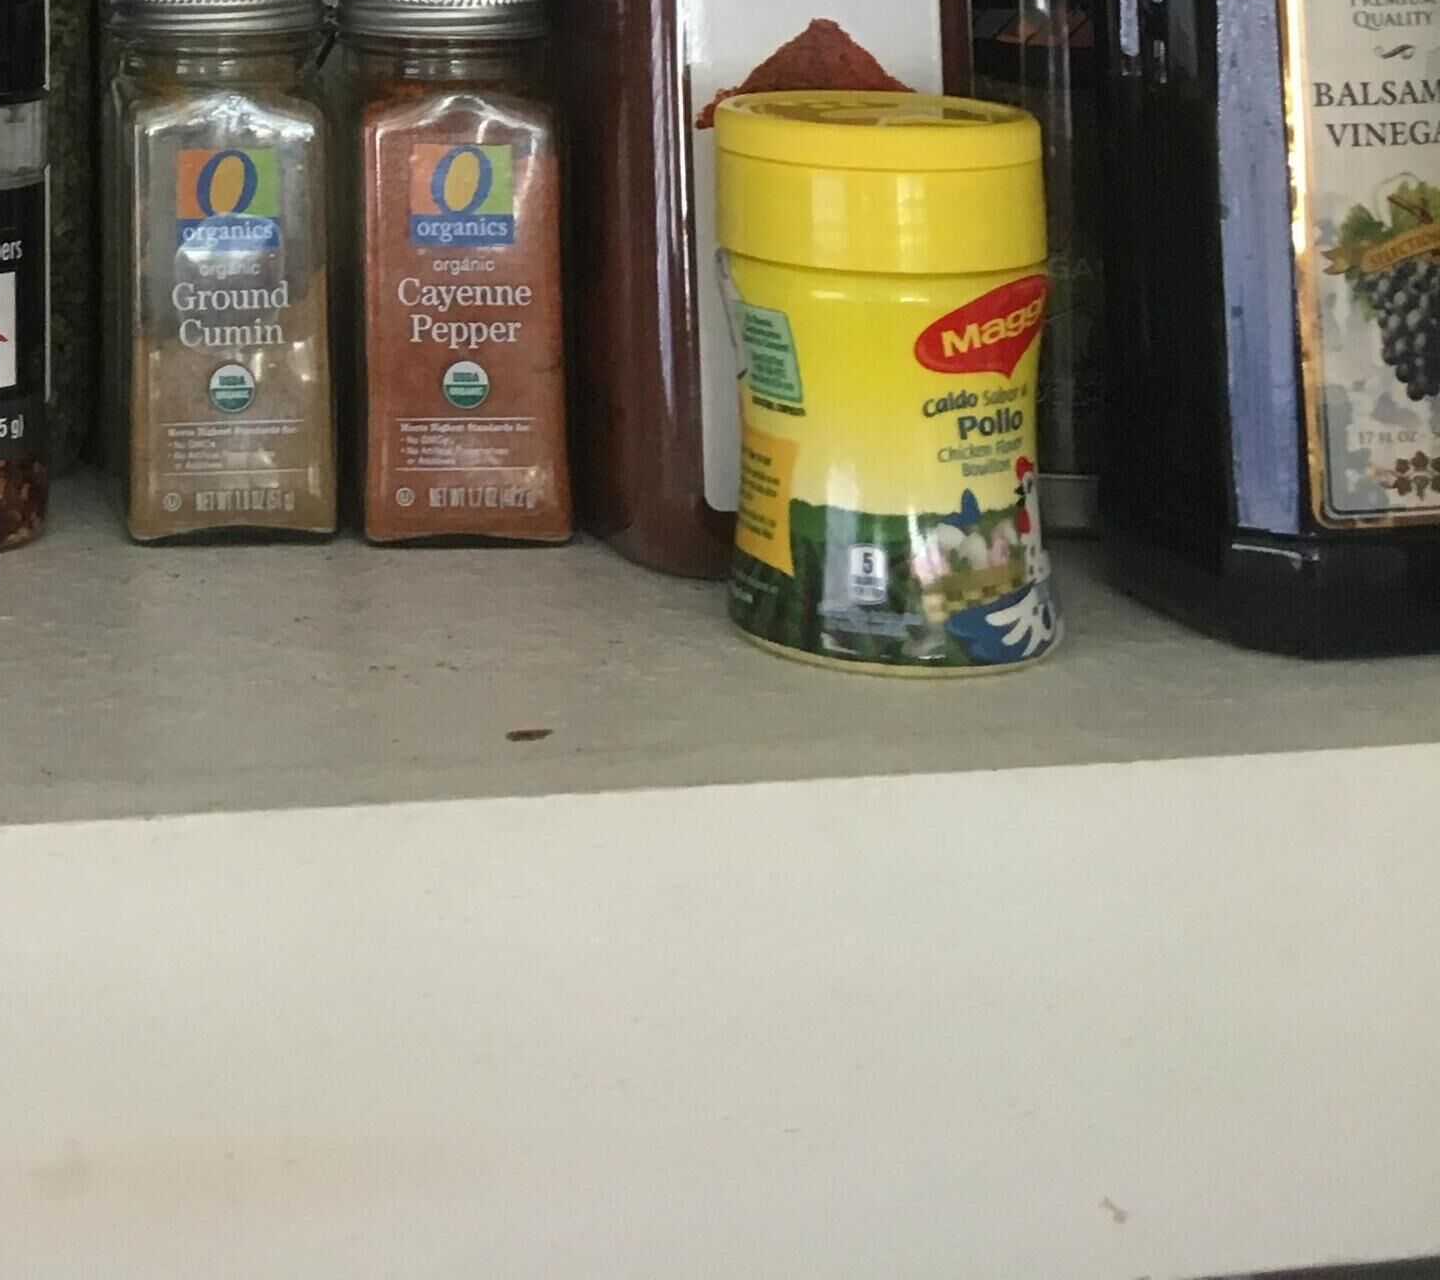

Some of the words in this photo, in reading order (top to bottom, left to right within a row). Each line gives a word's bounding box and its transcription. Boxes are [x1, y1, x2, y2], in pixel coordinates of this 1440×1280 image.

[1352, 11, 1433, 30] QUALITY
[182, 218, 274, 243] organics
[416, 218, 509, 243] organics
[199, 261, 261, 280] organic
[433, 257, 495, 277] organic
[172, 281, 290, 312] Ground
[397, 278, 532, 313] Cayenne
[179, 320, 283, 348] Cumin
[410, 315, 522, 348] Pepper
[923, 389, 978, 418] Caldo
[957, 407, 1023, 440] Pollo
